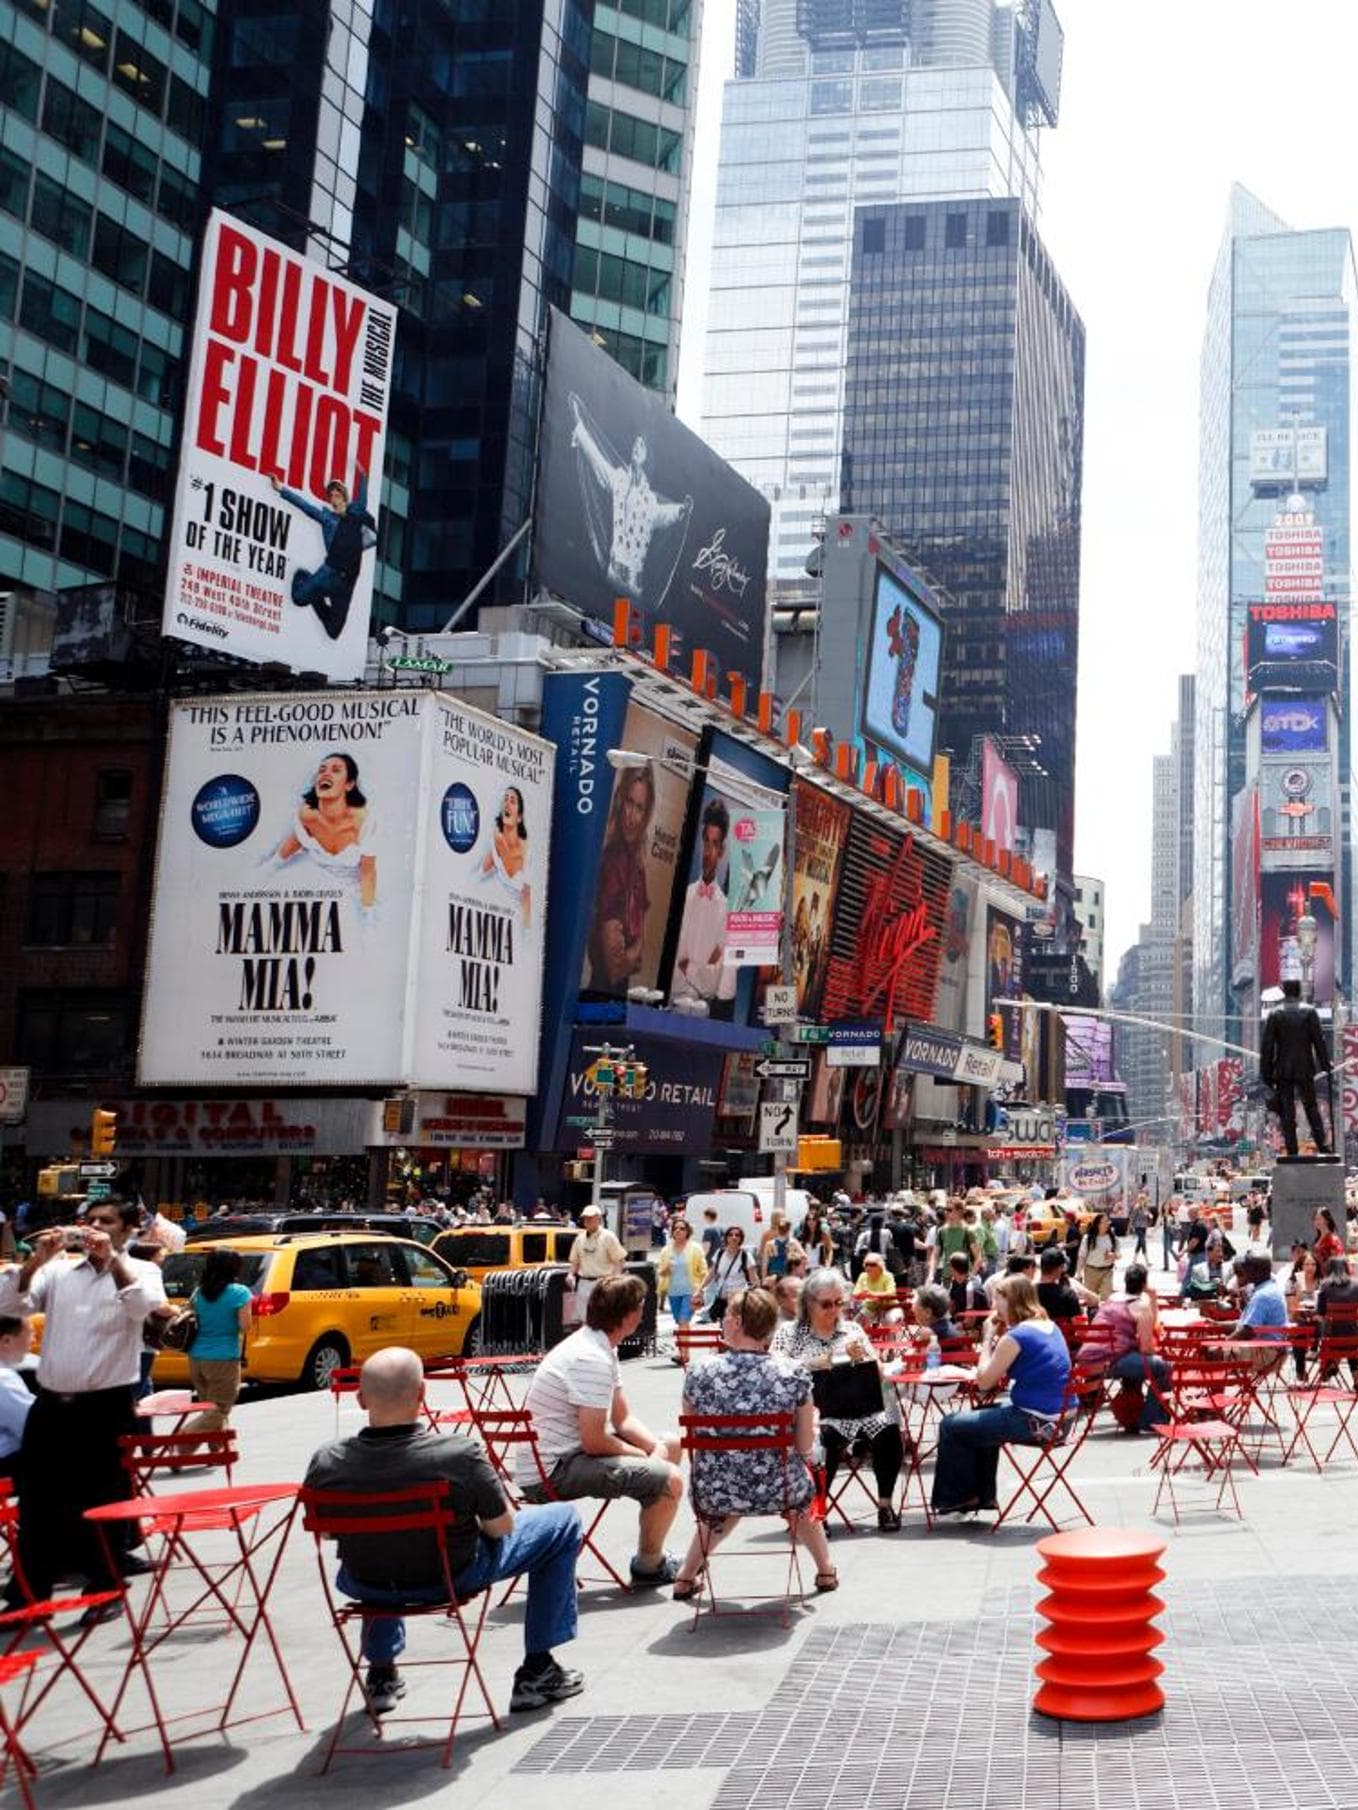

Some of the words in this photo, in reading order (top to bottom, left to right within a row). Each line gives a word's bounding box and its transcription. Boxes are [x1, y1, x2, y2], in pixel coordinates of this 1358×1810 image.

[209, 222, 366, 397] BILLY
[363, 307, 393, 379] MUSICAL
[360, 378, 384, 413] THE
[196, 338, 383, 501] ELLIOT
[219, 487, 292, 552] SHOW
[1268, 529, 1322, 541] TOSHIBA
[185, 520, 206, 551] OF
[213, 531, 241, 565] THE
[248, 543, 287, 581] YEAR
[1267, 546, 1322, 558] TOSHIBA
[1268, 562, 1322, 573] TOSHIBA
[1267, 578, 1322, 590] TOSHIBA
[1249, 603, 1337, 621] TOSHIBA
[188, 618, 230, 640] Fidelity
[395, 656, 448, 673] LAMAR
[235, 703, 335, 724] FEEL-GOOD
[341, 697, 420, 719] MUSICAL
[210, 726, 227, 745] IS
[232, 725, 244, 745] A
[443, 730, 494, 767] POPULAR
[576, 677, 601, 816] VORNADO
[214, 900, 344, 954] MAMMA
[445, 902, 513, 965] MAMMA
[237, 956, 316, 1011] MIA!
[457, 958, 499, 1014] MIA!
[774, 991, 789, 1003] NO
[768, 1006, 797, 1018] TURNS
[828, 1029, 881, 1039] VORNADO
[903, 1037, 961, 1069] VORNADO
[964, 1052, 998, 1081] Retail
[659, 1082, 716, 1107] RETAIL
[764, 1105, 781, 1118] NO
[766, 1136, 793, 1147] TURN
